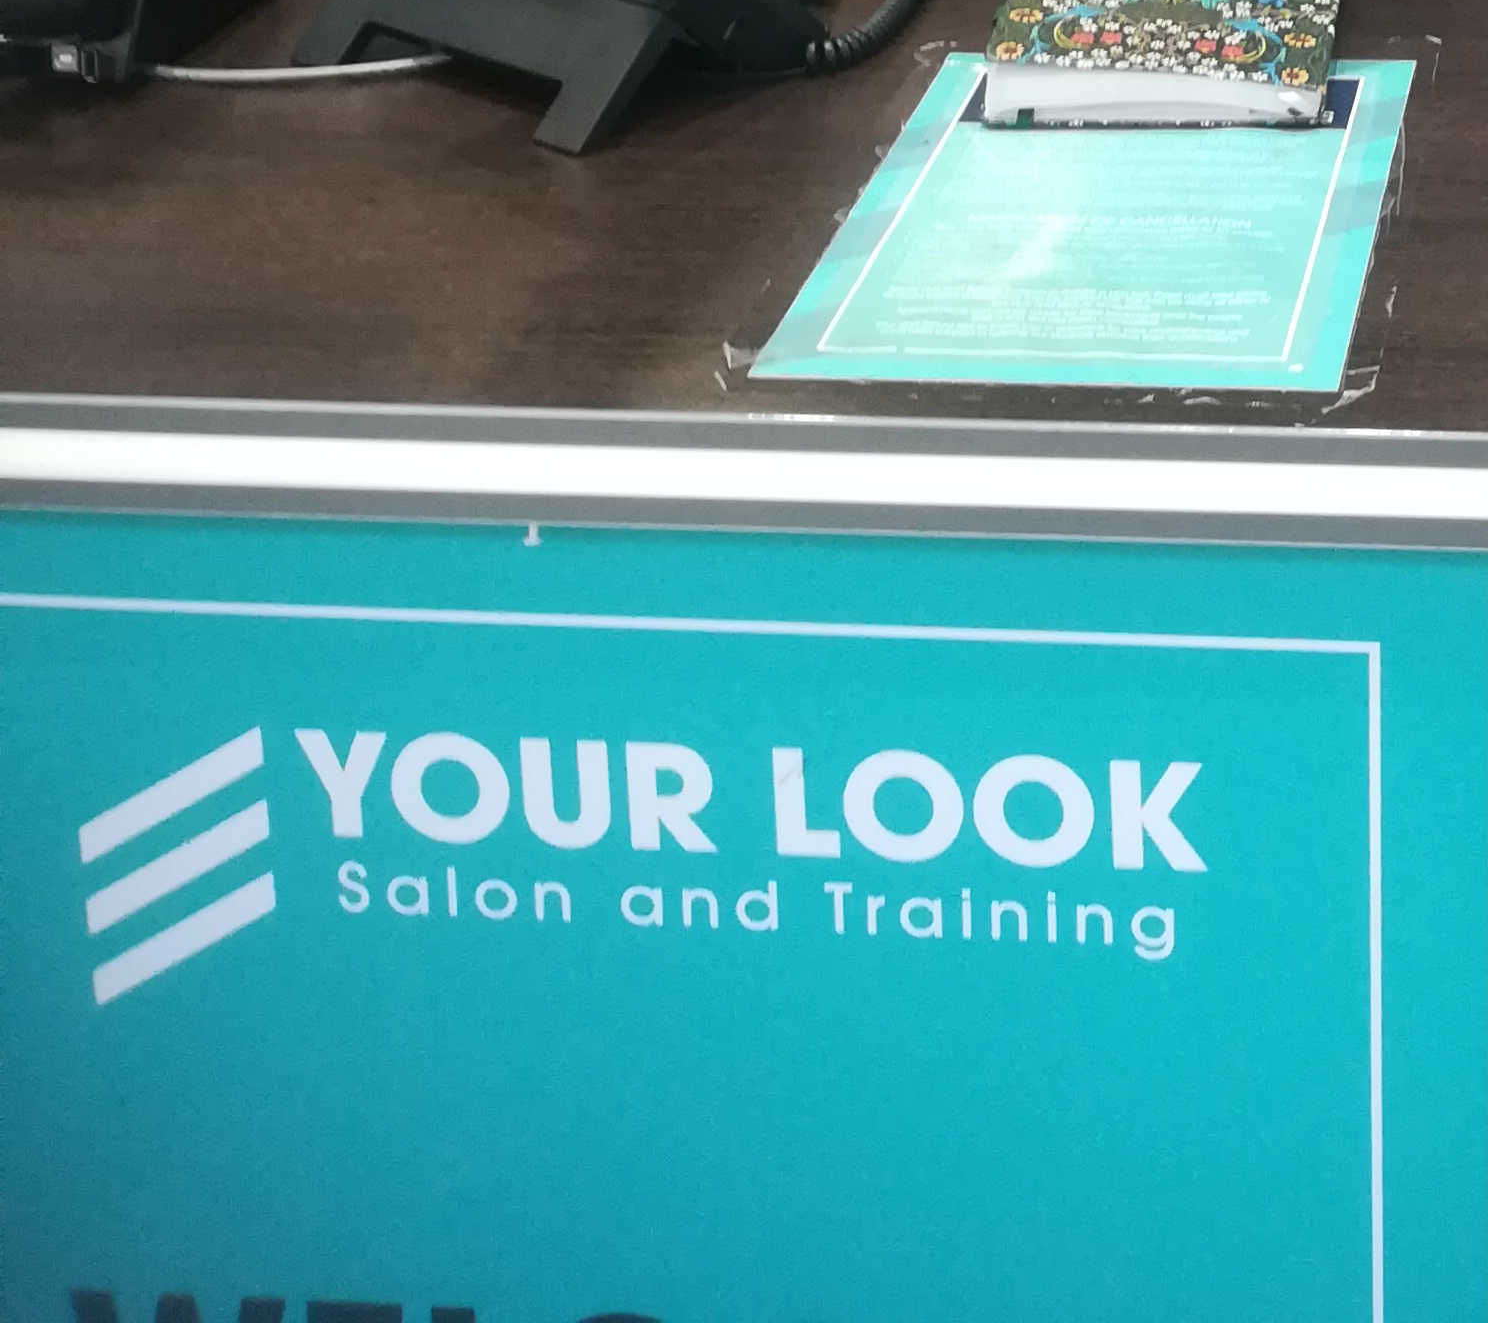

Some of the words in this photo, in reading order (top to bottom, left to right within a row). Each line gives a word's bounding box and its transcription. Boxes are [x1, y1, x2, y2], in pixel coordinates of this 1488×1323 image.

[294, 728, 719, 854] YOUR
[771, 746, 1208, 872] LOOK
[337, 860, 571, 923] Salon
[619, 880, 779, 932] and
[824, 881, 1175, 960] Training
